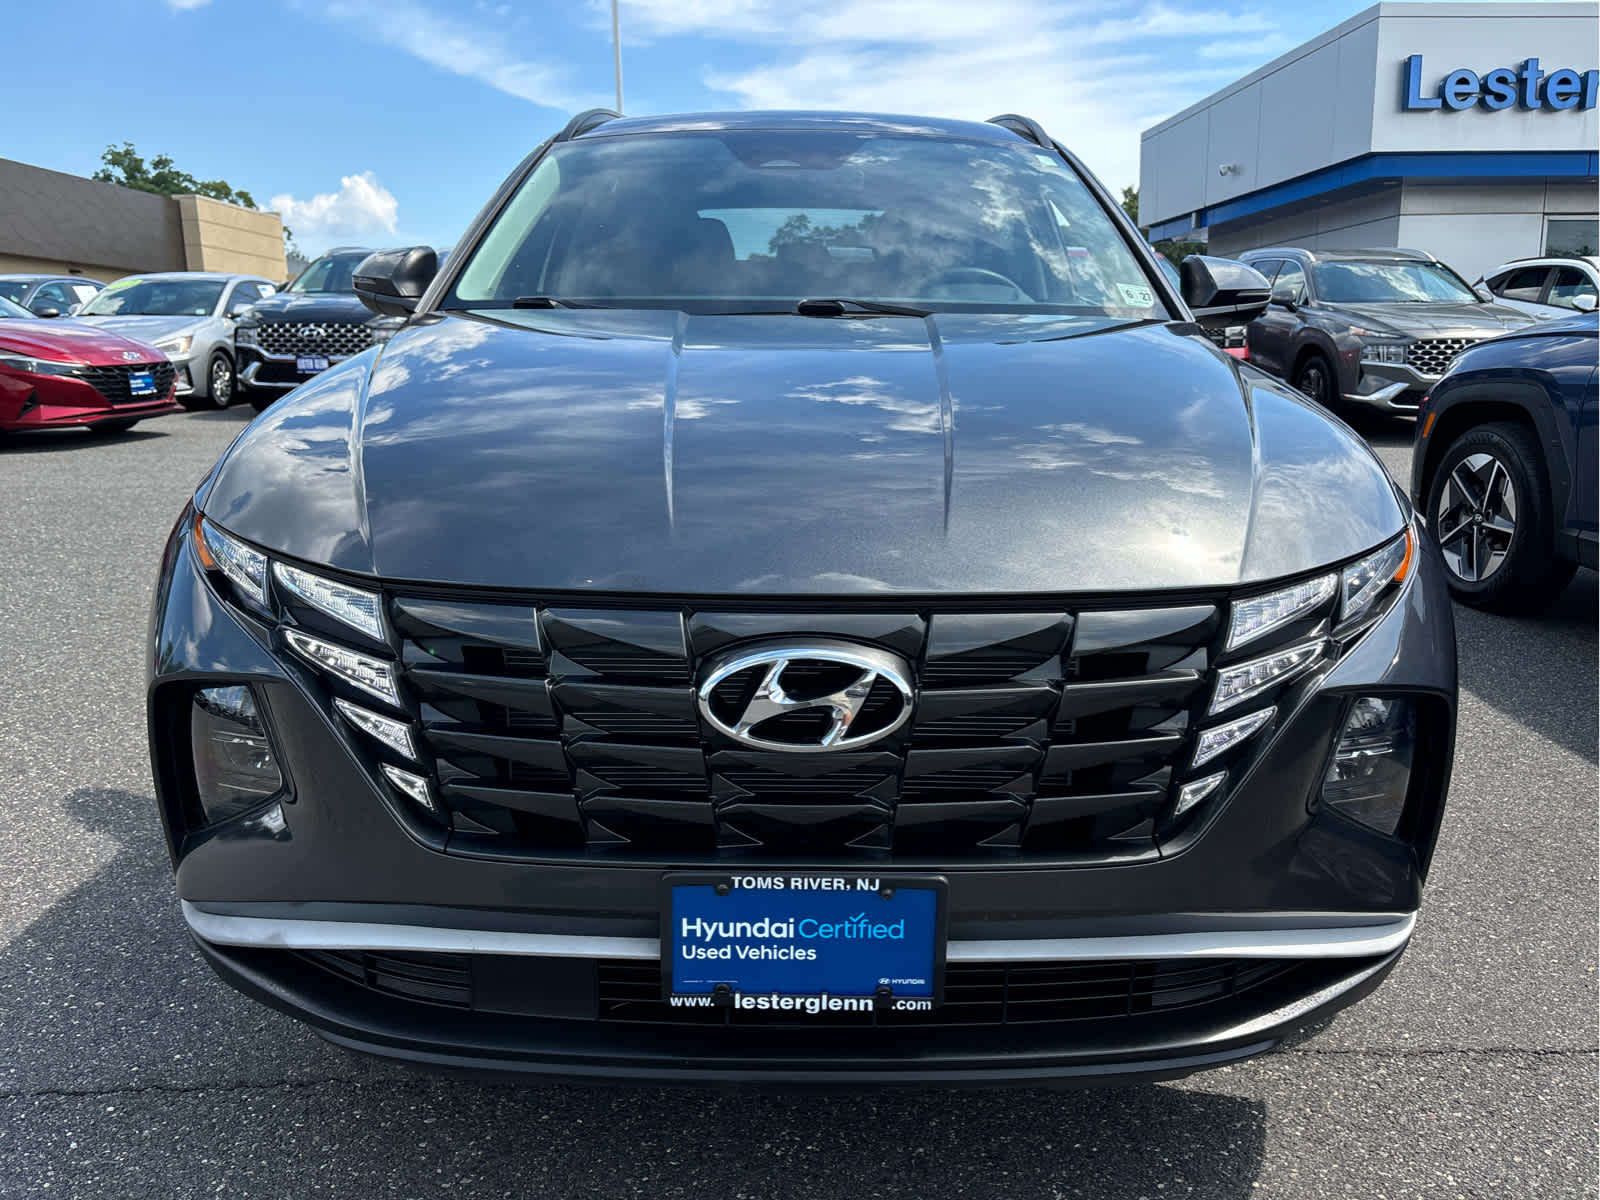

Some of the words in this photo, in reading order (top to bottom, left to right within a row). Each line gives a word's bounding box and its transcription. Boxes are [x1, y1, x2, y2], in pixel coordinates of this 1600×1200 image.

[730, 876, 785, 890] TOMS
[790, 877, 851, 891] RIVER,
[856, 878, 880, 892] NJ
[681, 917, 795, 942] Hyundai
[798, 912, 905, 940] Certified
[682, 944, 732, 960] Used
[735, 944, 817, 961] Vehicles
[669, 995, 715, 1007] www.
[734, 992, 874, 1014] lesterglenn
[891, 999, 932, 1011] .com
